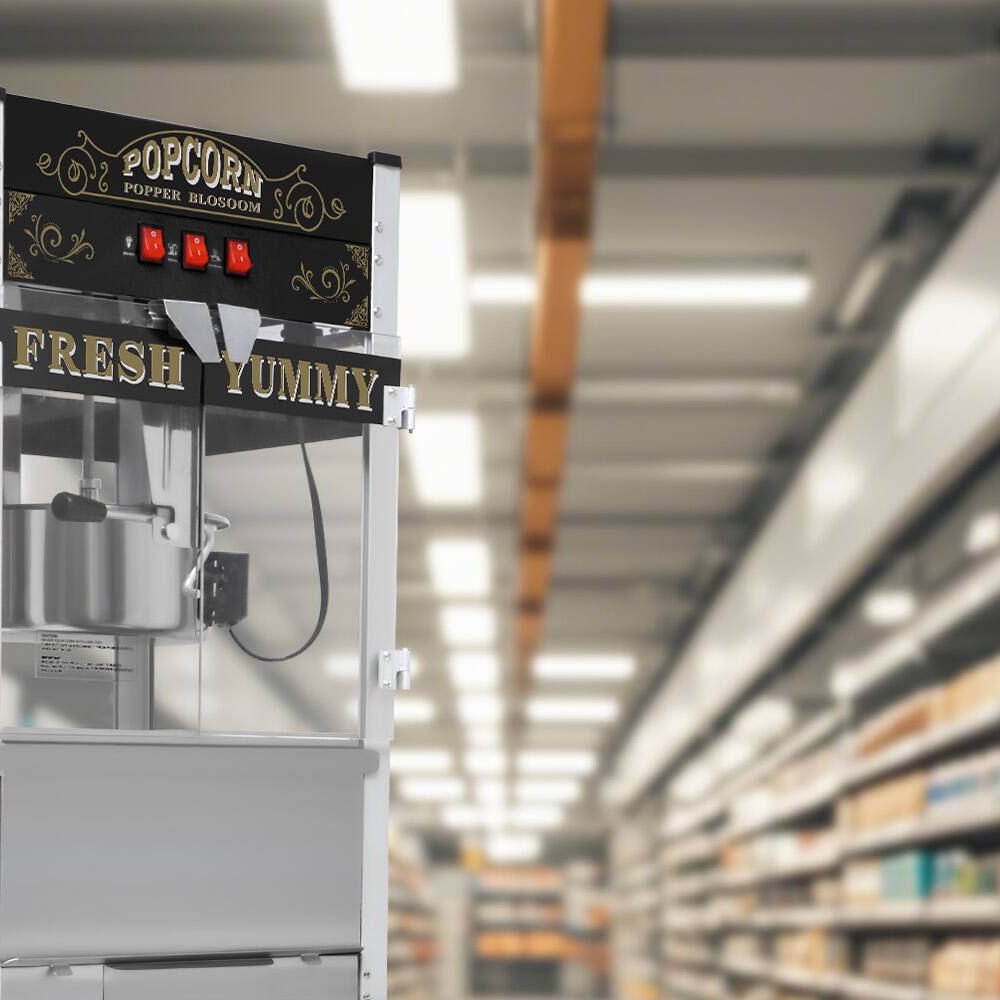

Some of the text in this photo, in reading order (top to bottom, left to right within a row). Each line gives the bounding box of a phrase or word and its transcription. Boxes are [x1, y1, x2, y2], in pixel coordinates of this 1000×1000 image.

[122, 136, 264, 198] POPCORN
[124, 182, 262, 214] POPPER BLOSOOM
[12, 326, 185, 391] FRESH
[221, 350, 379, 412] YUMMY
